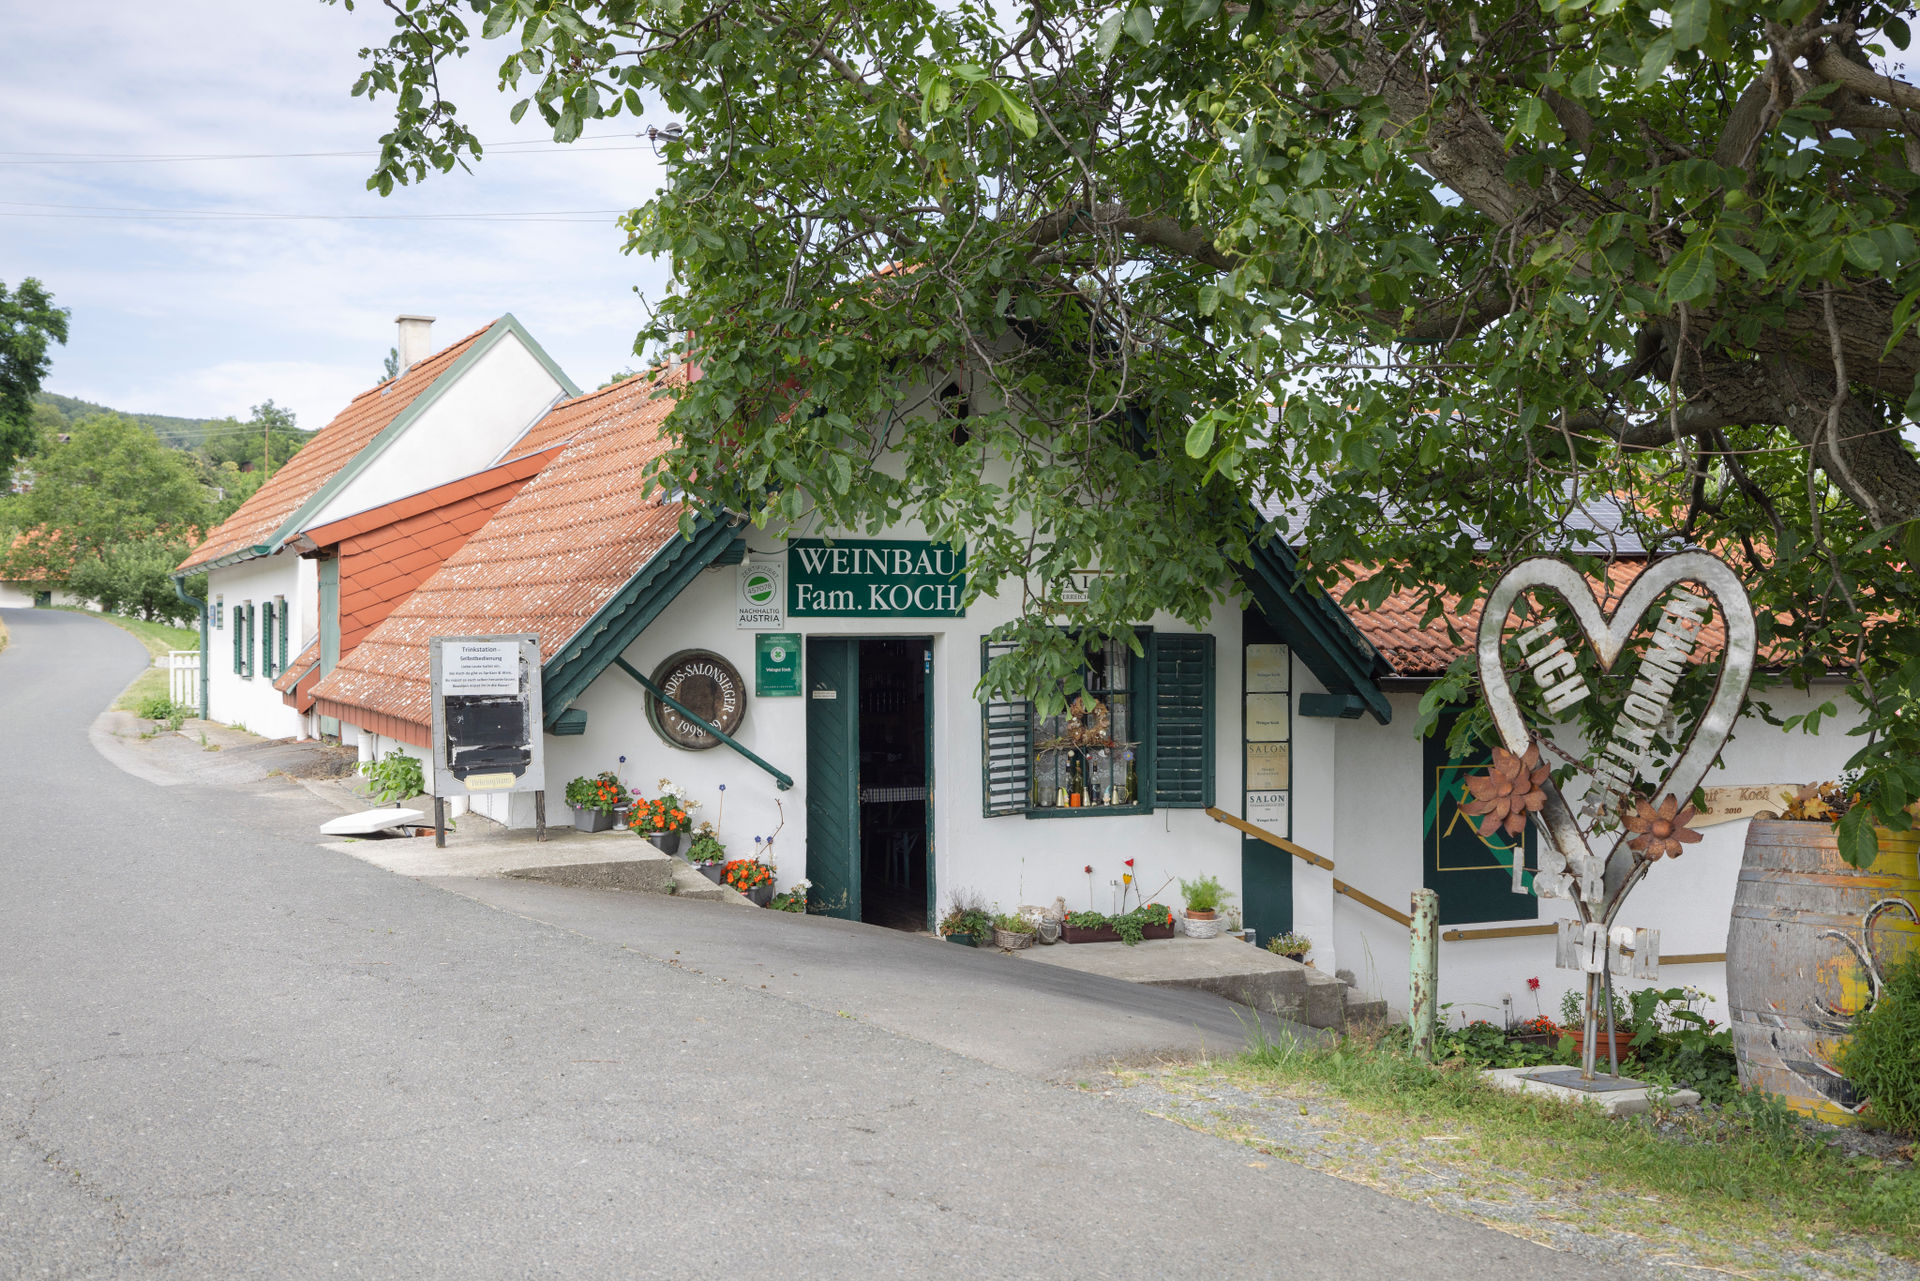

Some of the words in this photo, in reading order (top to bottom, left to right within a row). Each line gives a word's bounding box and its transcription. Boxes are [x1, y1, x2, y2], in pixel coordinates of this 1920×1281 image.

[795, 548, 955, 575] WEINBAU
[1051, 576, 1088, 588] SAL
[796, 584, 862, 610] Fam.
[868, 584, 958, 610] KOCH
[1517, 617, 1590, 715] LICH
[1249, 744, 1287, 753] SALON
[1250, 795, 1285, 803] SALON
[1511, 847, 1528, 894] L
[1556, 918, 1660, 981] KOCH
